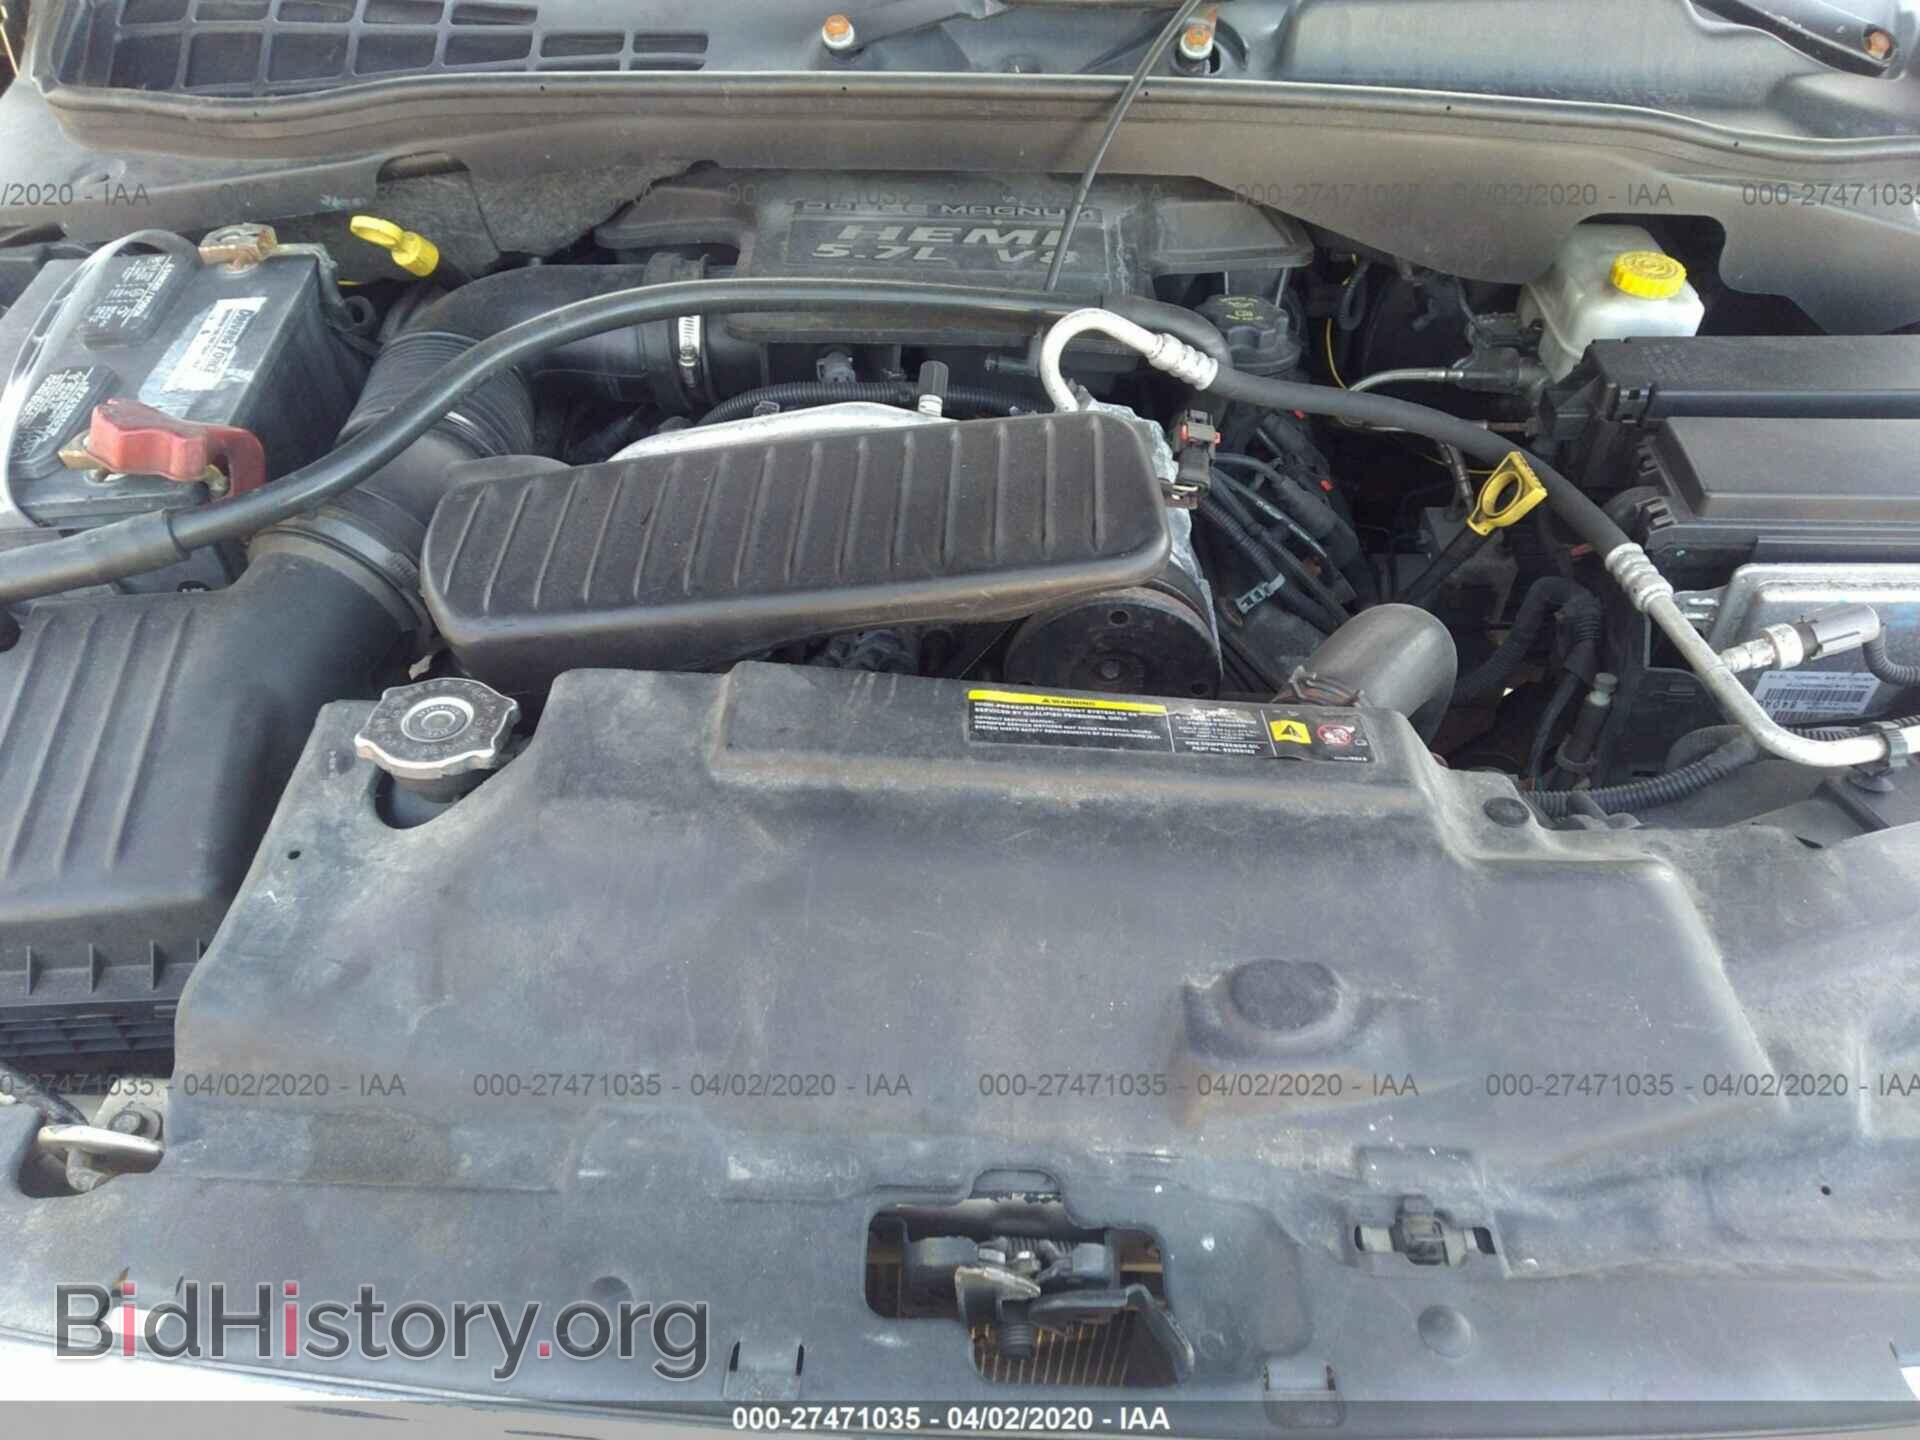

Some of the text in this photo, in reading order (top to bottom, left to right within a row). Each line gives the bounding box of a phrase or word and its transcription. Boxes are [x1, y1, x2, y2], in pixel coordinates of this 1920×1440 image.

[837, 225, 1066, 246] HEMI
[812, 243, 1081, 264] 5.7L V8
